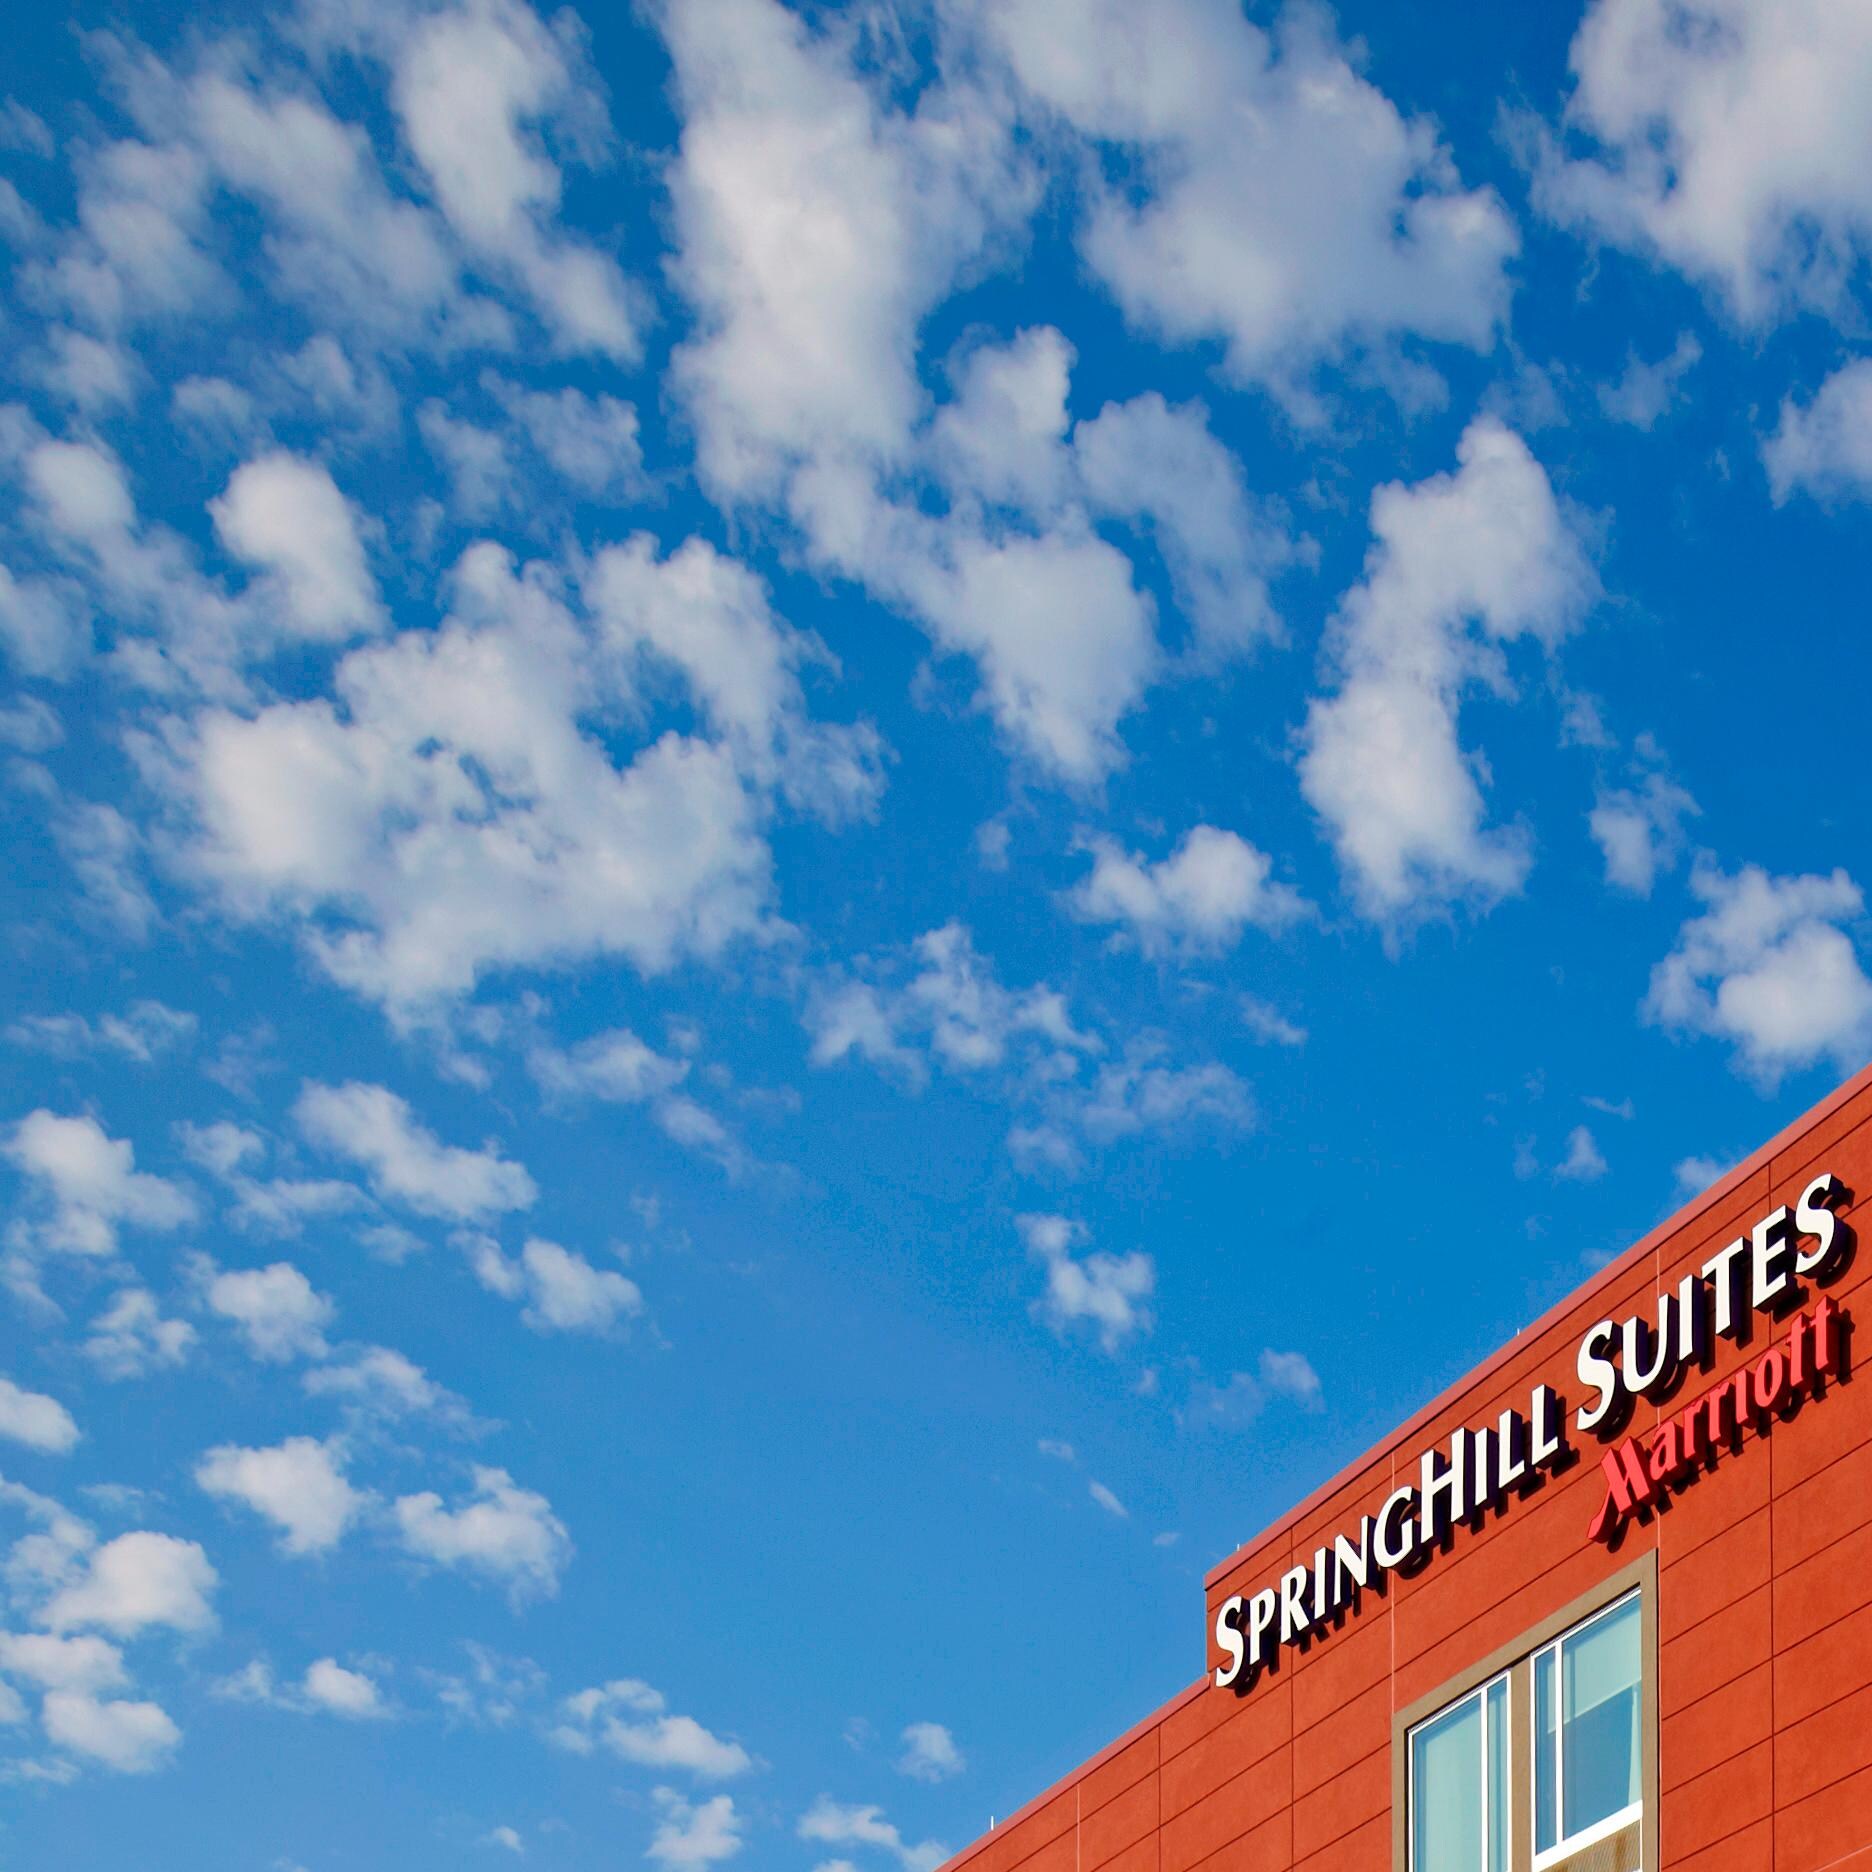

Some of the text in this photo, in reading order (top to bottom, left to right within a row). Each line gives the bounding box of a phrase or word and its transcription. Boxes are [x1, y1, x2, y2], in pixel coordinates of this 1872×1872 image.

[1214, 1172, 1840, 1689] SPRINGHILL SUITES
[1585, 1294, 1841, 1543] Marriott
